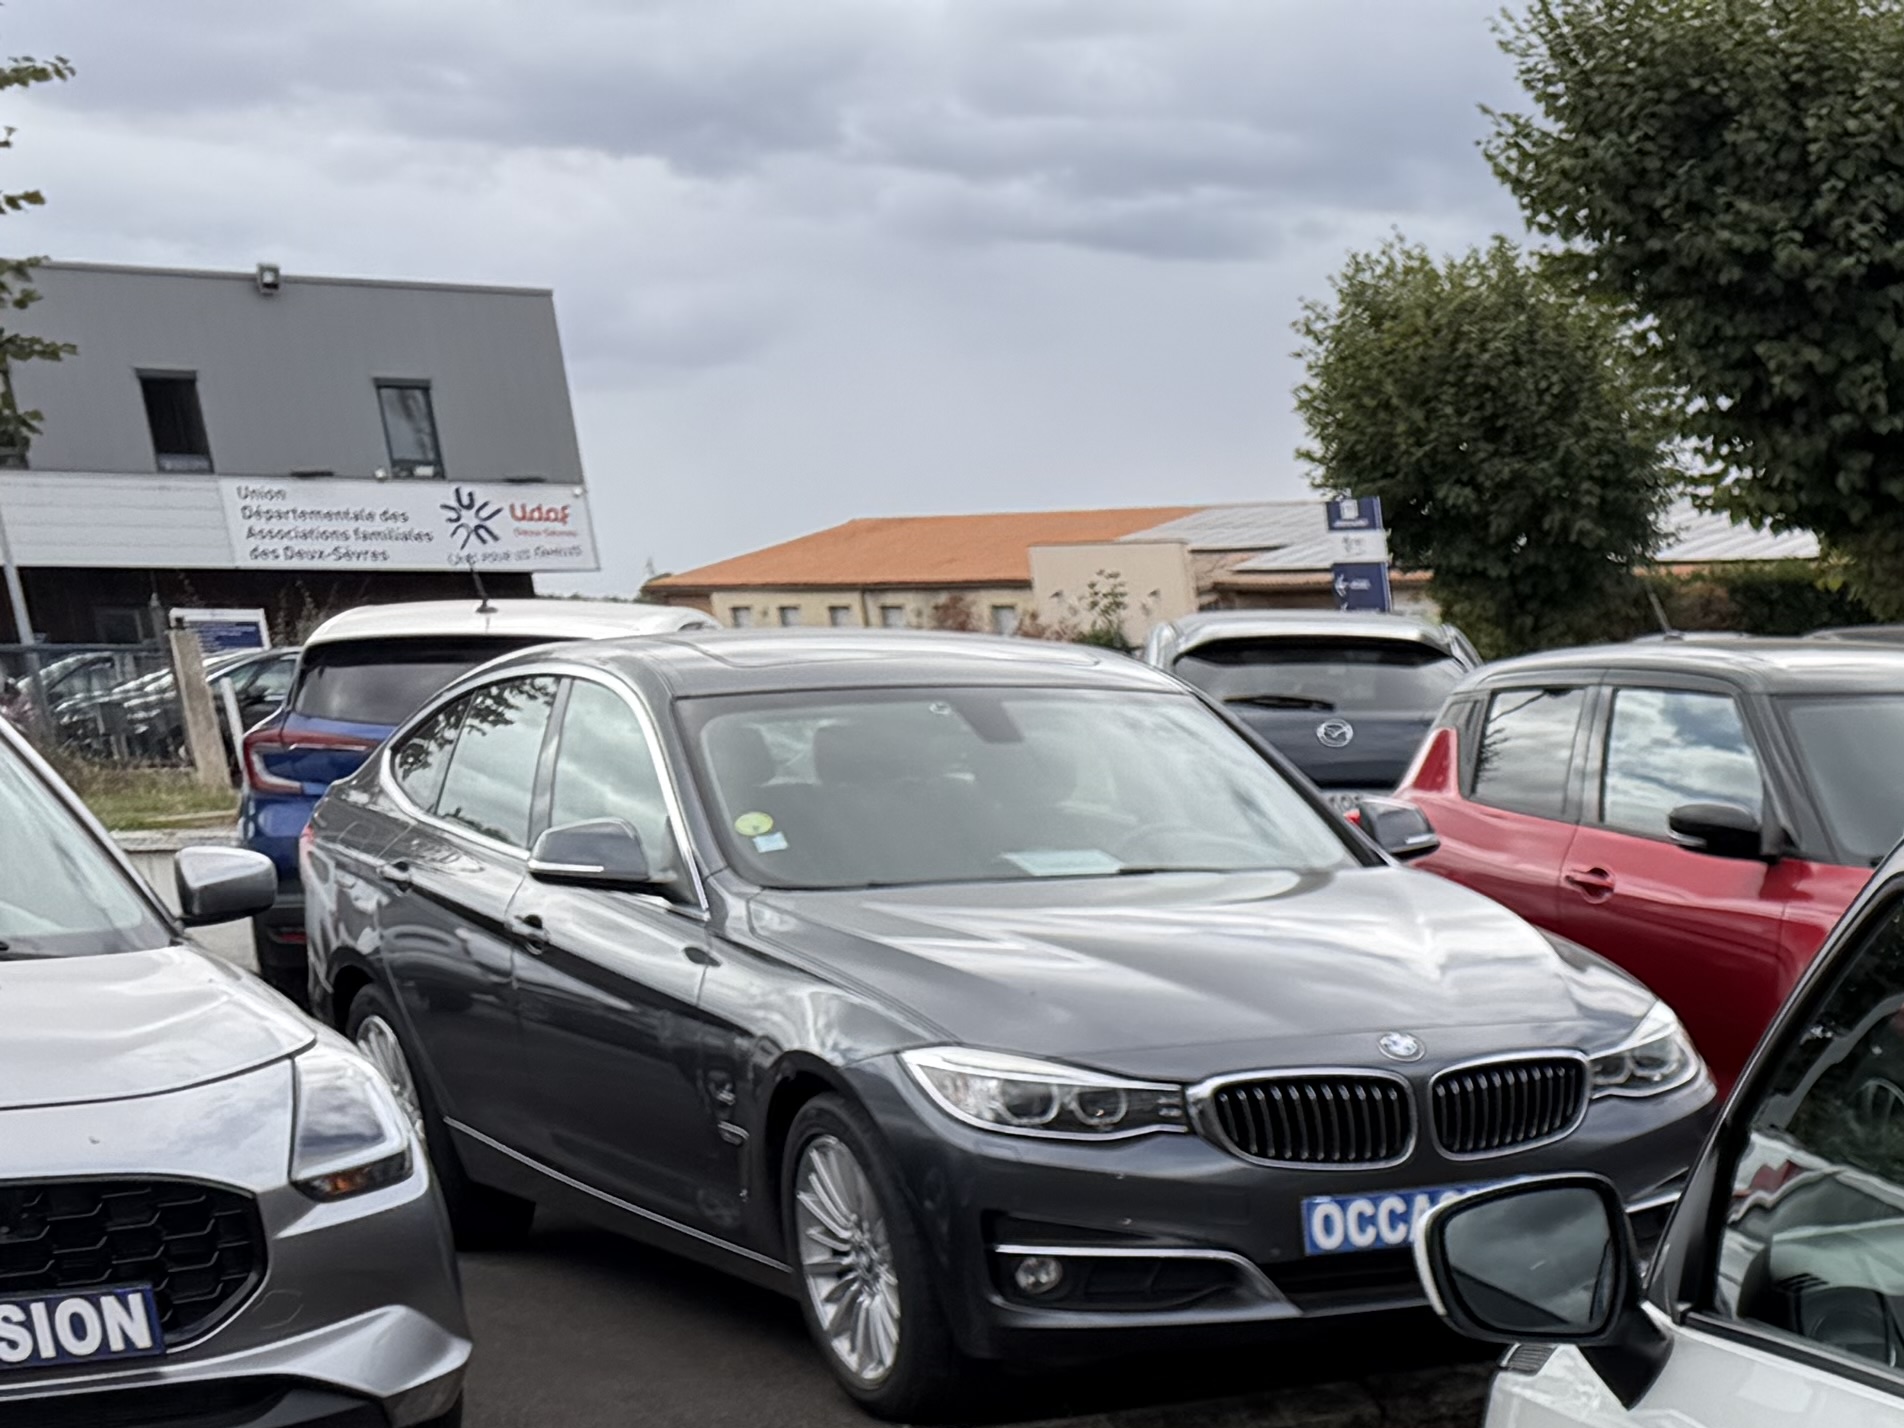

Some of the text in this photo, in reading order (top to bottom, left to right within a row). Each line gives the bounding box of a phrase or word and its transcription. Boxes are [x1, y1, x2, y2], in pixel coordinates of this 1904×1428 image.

[236, 486, 287, 501] Union
[240, 504, 409, 524] Départementale des
[245, 525, 350, 542] Associations
[249, 545, 280, 561] des
[1312, 1190, 1458, 1250] OCCA
